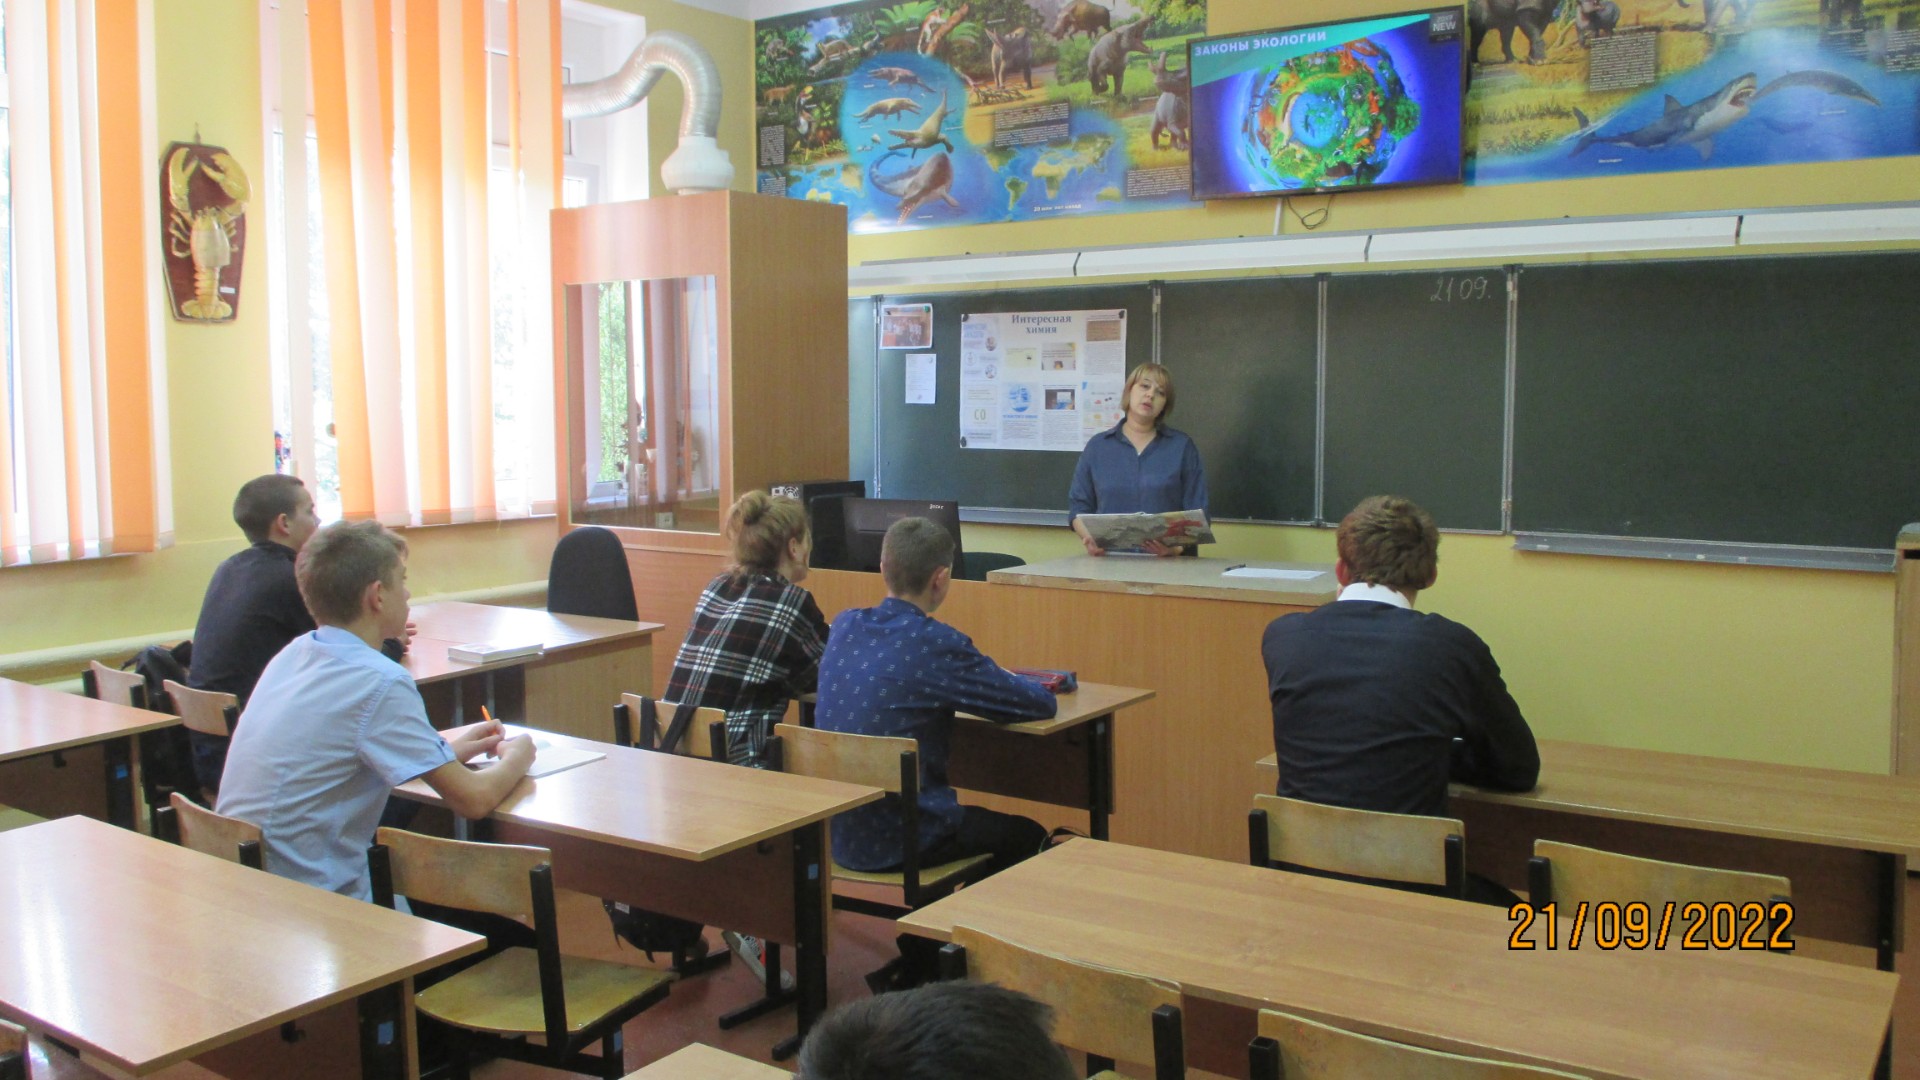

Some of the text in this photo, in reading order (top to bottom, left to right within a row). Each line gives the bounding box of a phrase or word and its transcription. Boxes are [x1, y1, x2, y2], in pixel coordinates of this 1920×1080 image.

[1432, 21, 1457, 32] NEW
[1195, 31, 1327, 57] ЗАКОНЫ ЭКОЛОГИИ
[1011, 314, 1072, 326] Интересная
[1026, 326, 1057, 334] химия
